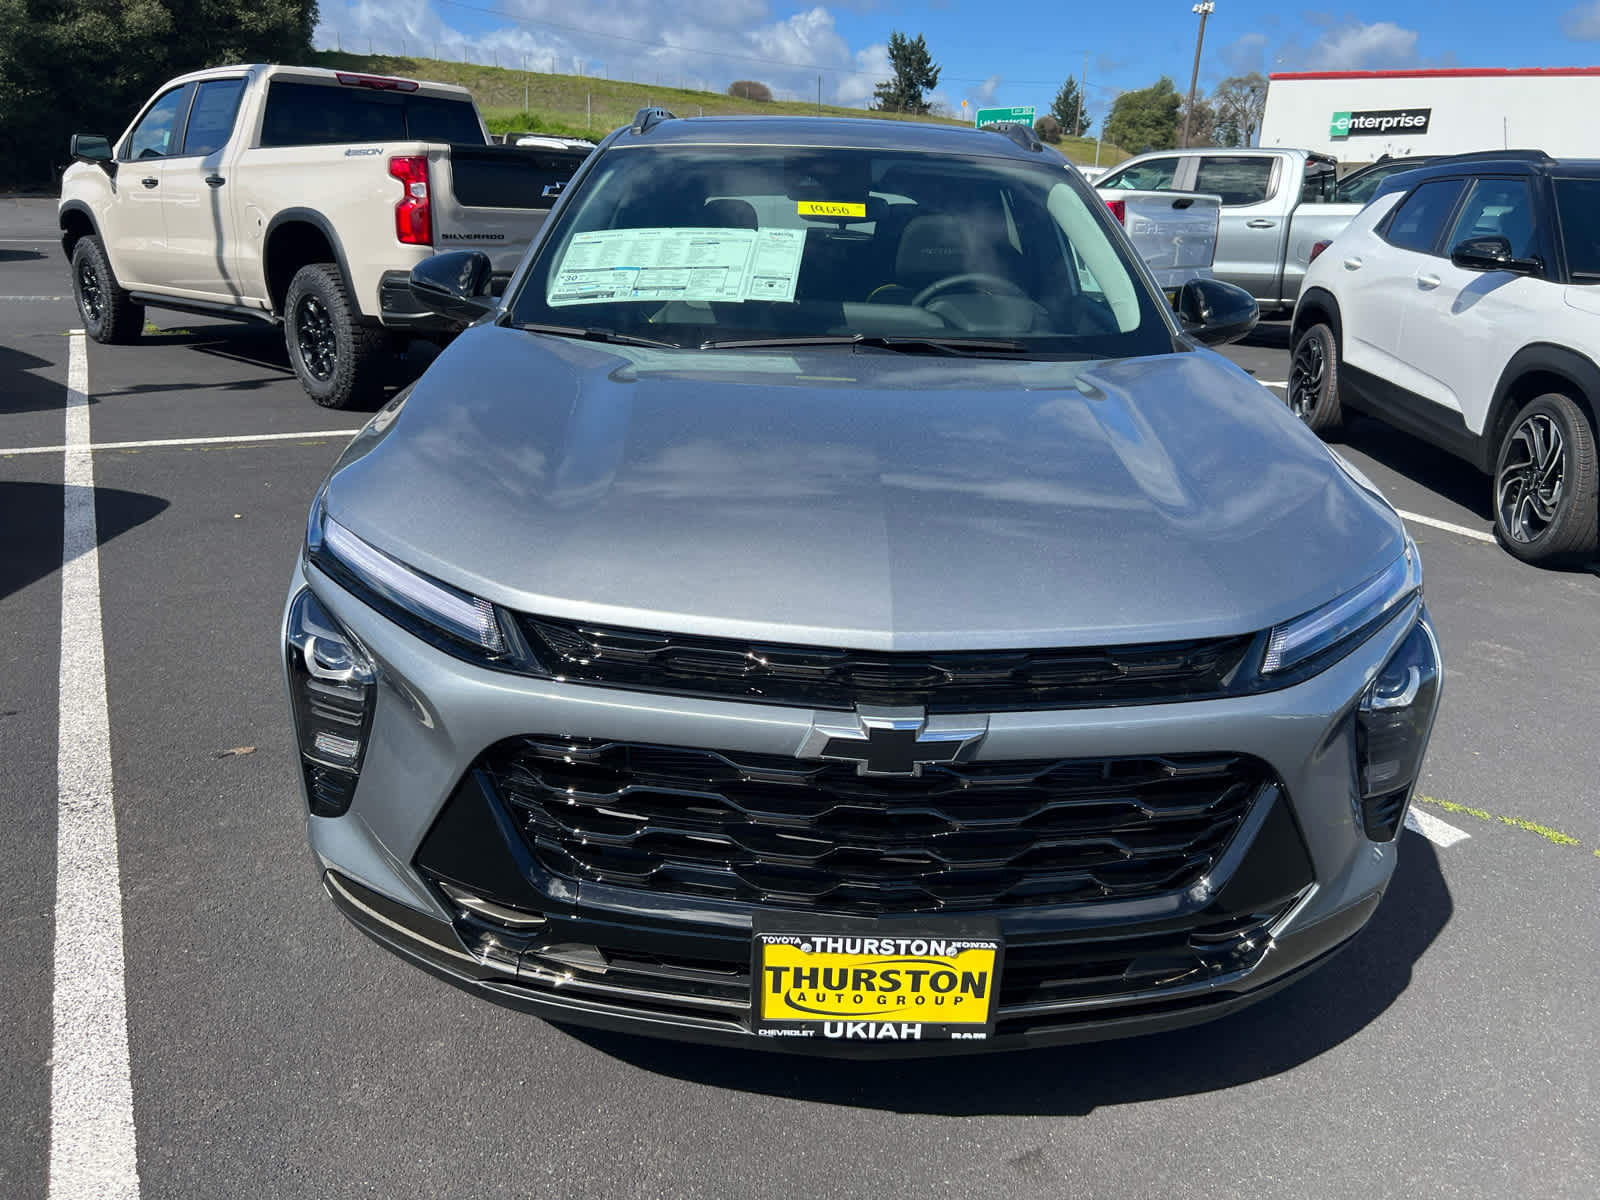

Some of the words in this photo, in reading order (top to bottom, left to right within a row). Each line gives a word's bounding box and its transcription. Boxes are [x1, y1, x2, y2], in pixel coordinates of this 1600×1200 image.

[1334, 112, 1426, 131] enterprise
[441, 233, 505, 241] SILVERADO
[761, 936, 802, 945] TOYOTA
[951, 941, 997, 949] HONDA
[811, 937, 946, 956] THURSTON
[765, 966, 988, 998] THURSTON
[797, 992, 864, 1005] AUTO
[877, 995, 964, 1006] GROUP
[758, 1028, 816, 1037] CHEVROLET
[823, 1021, 922, 1040] UKIAH
[951, 1032, 987, 1040] RAM
